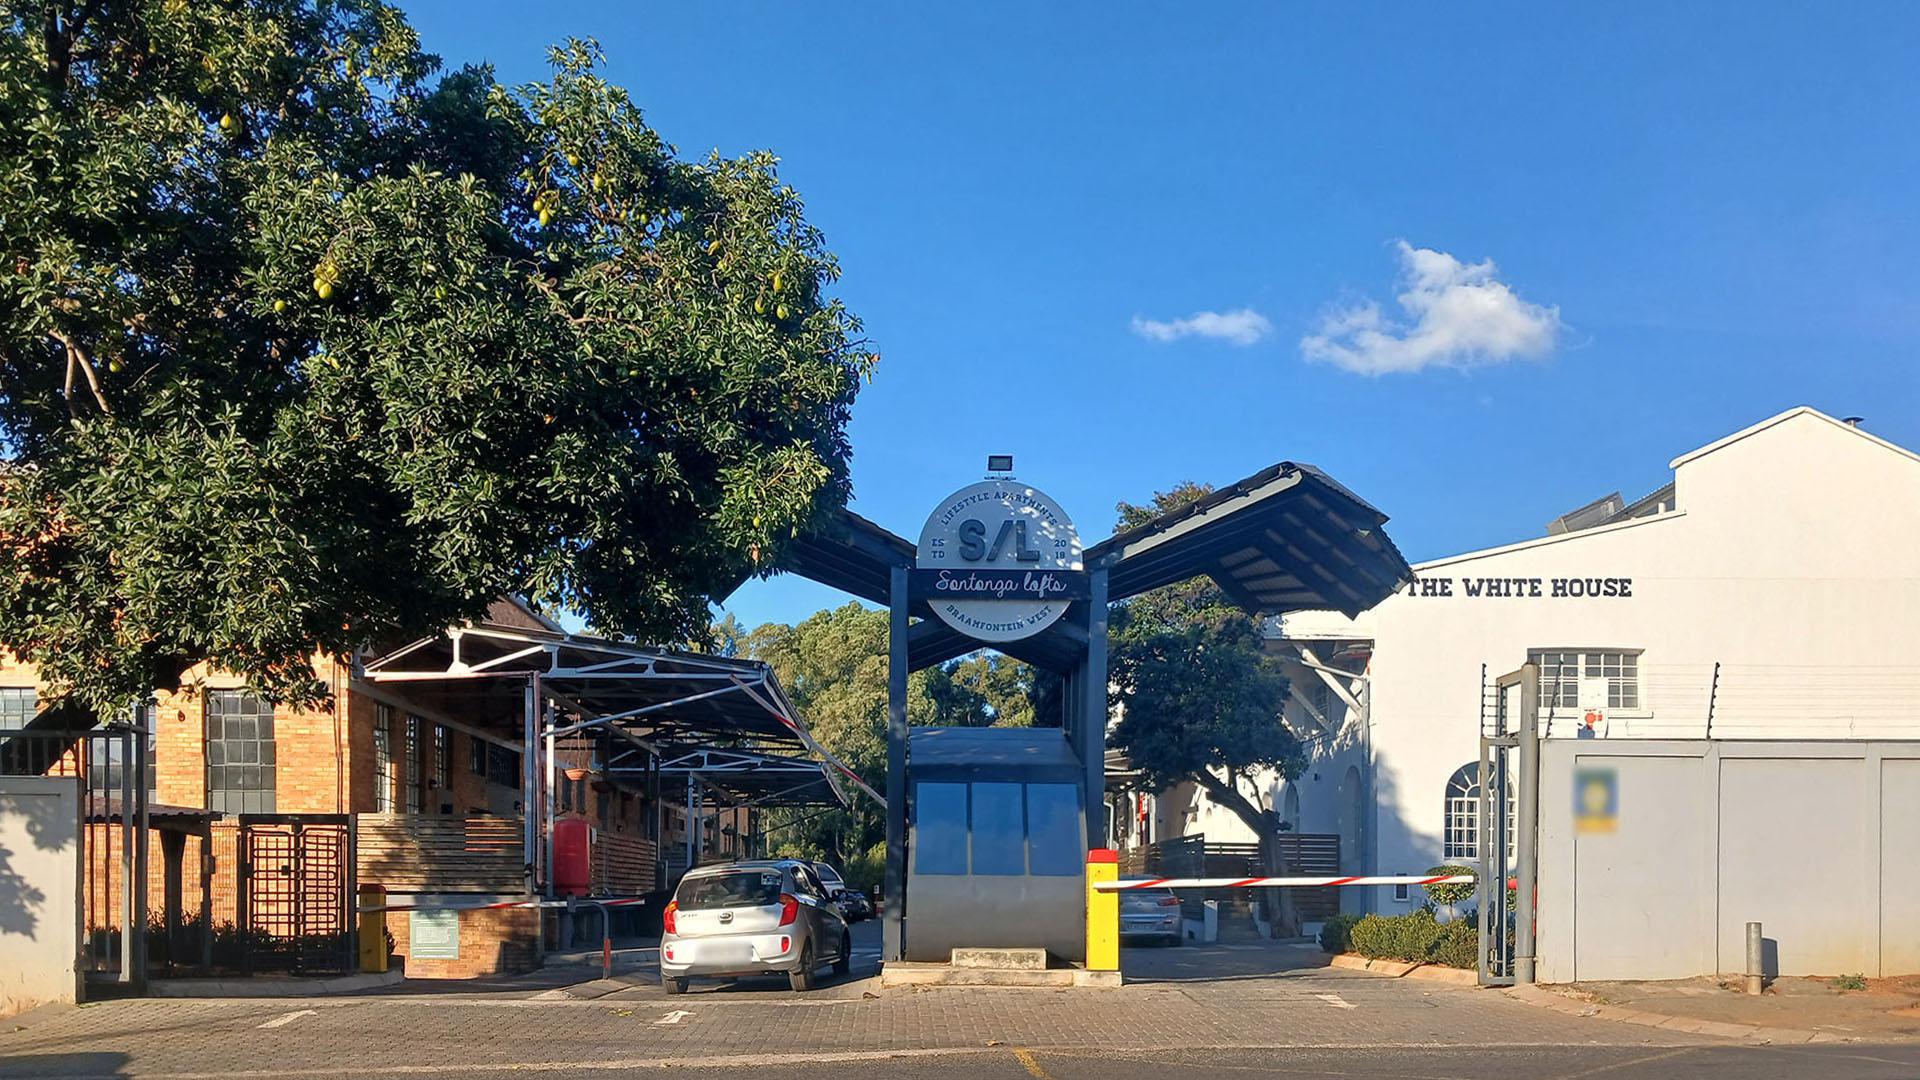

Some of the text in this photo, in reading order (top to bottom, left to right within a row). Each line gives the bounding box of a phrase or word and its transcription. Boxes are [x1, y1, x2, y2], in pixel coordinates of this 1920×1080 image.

[941, 491, 1058, 526] LIFESTYLE APARTMENTS
[931, 538, 945, 547] ES
[959, 518, 1040, 562] S/L
[1054, 539, 1067, 548] 20
[931, 550, 945, 559] TD
[1055, 551, 1065, 560] 18
[936, 569, 1018, 598] Sontonga
[1407, 577, 1633, 597] THE WHITE HOUSE
[946, 604, 1053, 632] BRAAMFONTEIN WEST
